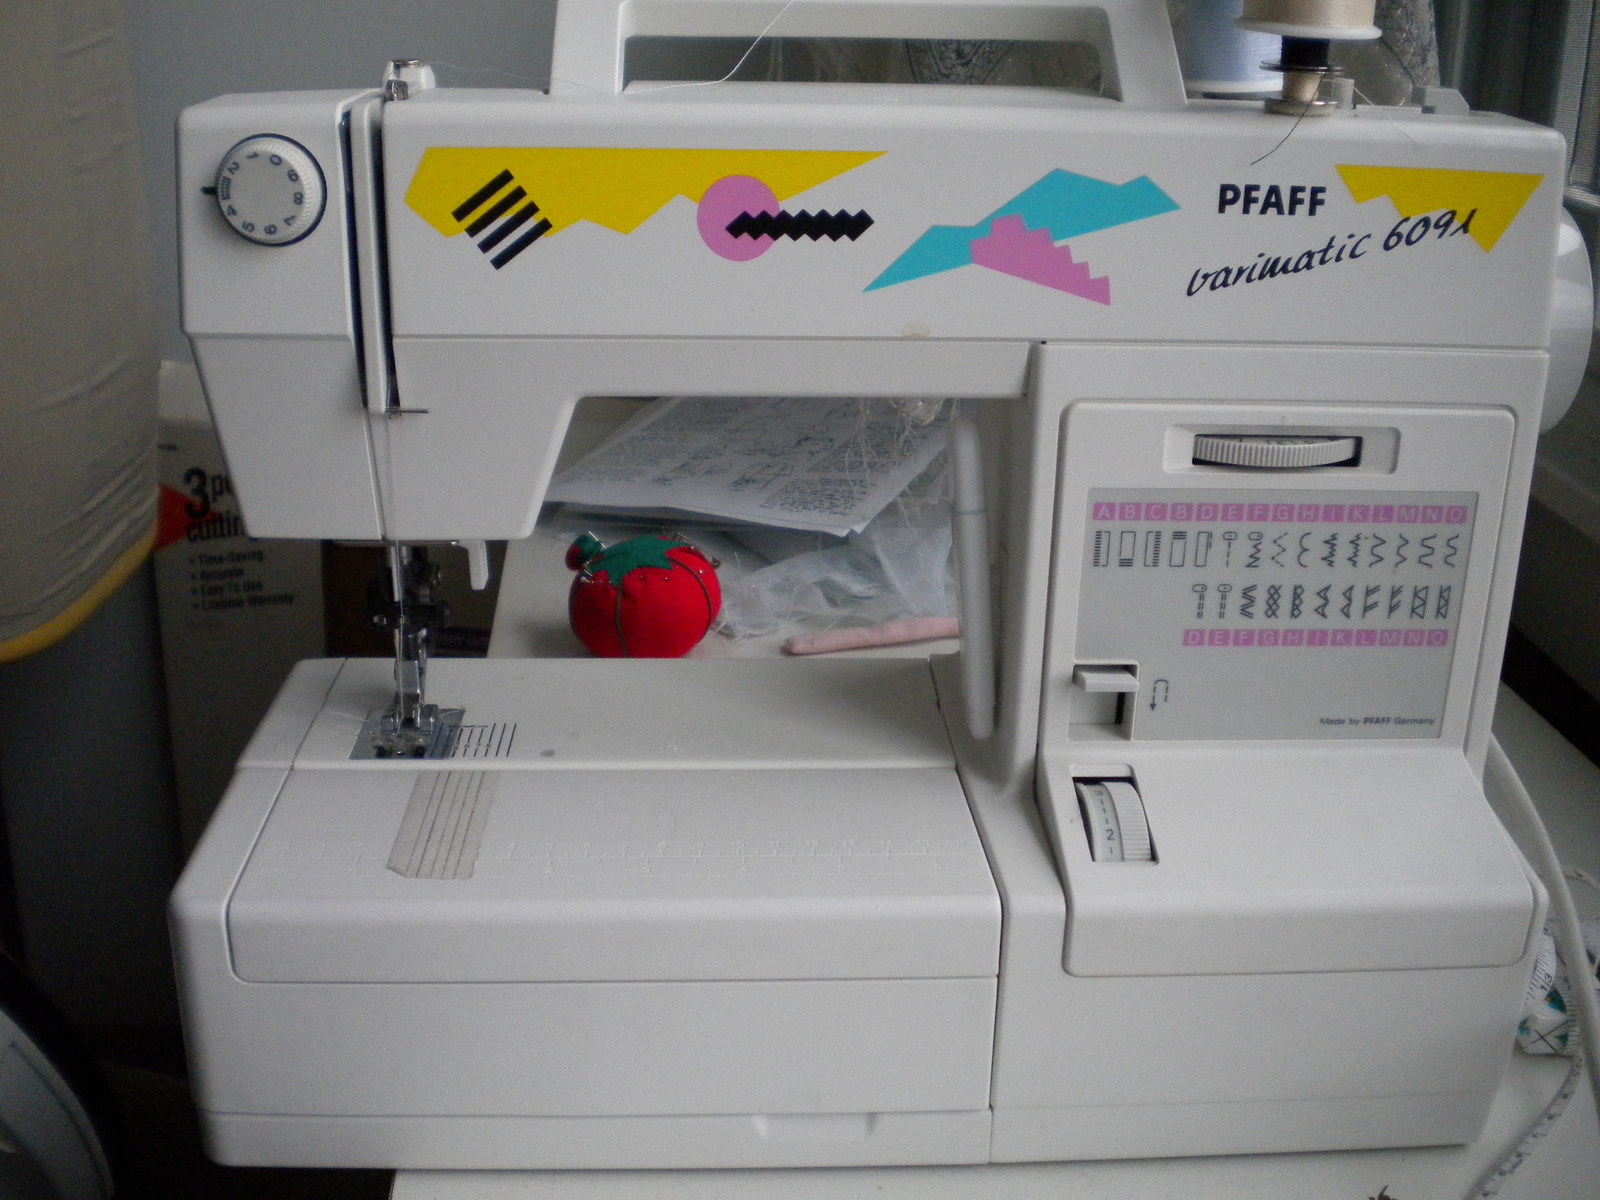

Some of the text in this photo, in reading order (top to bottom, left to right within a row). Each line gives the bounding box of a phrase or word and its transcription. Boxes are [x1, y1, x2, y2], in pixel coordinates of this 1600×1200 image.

[293, 192, 304, 205] 8
[1218, 183, 1326, 216] PFAFF
[1186, 232, 1372, 297] varimatic
[184, 467, 210, 519] 3
[1098, 505, 1110, 519] A
[1125, 506, 1135, 519] B
[1150, 506, 1161, 519] C
[1201, 506, 1213, 520] D
[1228, 506, 1238, 520] E
[1255, 506, 1264, 520] F
[1278, 506, 1289, 520] G
[1302, 507, 1314, 520] H
[1380, 508, 1388, 521] L
[1188, 631, 1200, 644] D
[1214, 631, 1224, 644] E
[1240, 631, 1248, 644] F
[1265, 631, 1275, 644] G
[1286, 631, 1299, 644] H
[1361, 631, 1370, 644] L
[1382, 631, 1398, 644] M
[1408, 631, 1420, 644] N
[1320, 716, 1435, 726] Made by PFAFF Germany
[1106, 829, 1116, 841] 2
